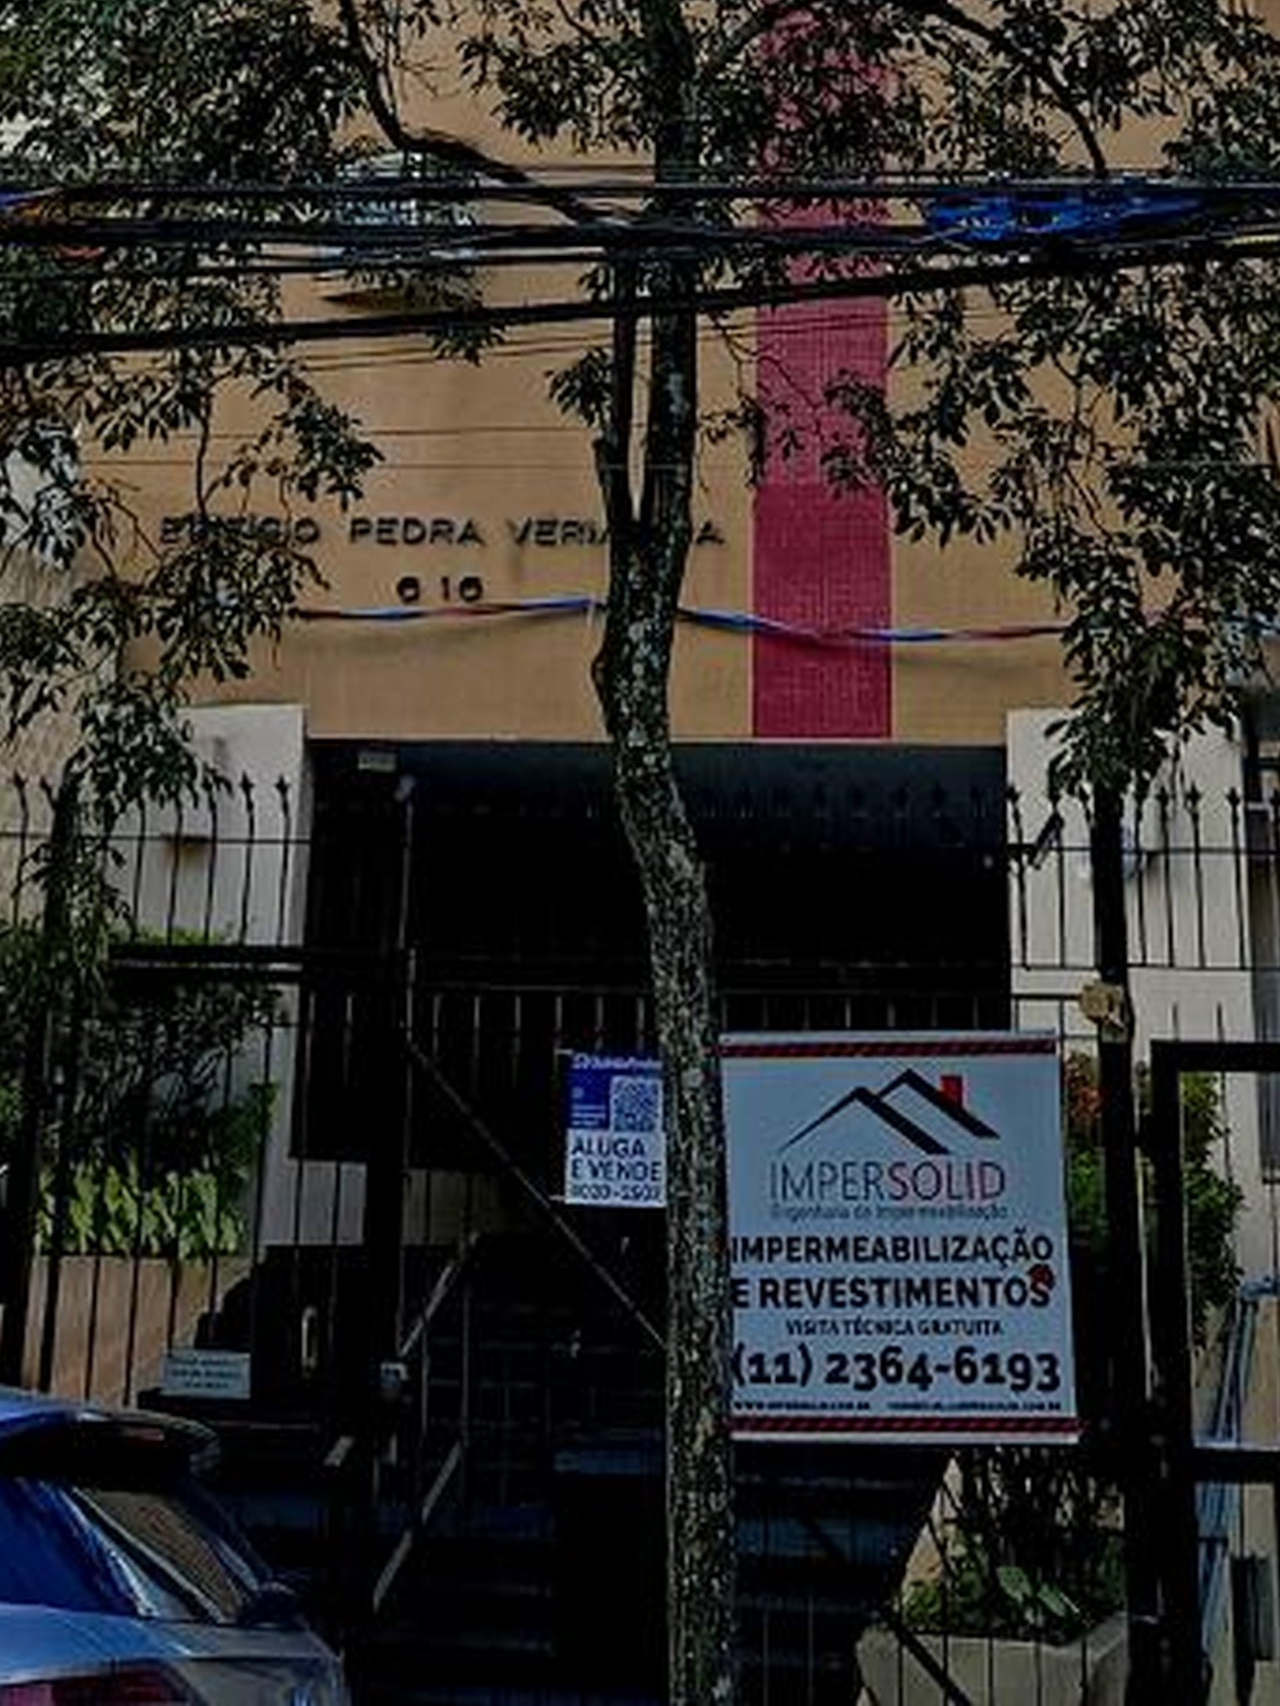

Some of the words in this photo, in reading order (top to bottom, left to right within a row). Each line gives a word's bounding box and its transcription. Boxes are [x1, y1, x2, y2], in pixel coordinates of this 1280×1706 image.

[351, 517, 485, 545] PEDRA
[571, 1139, 645, 1158] ALUGA
[587, 1160, 662, 1181] VENDE
[771, 1161, 1006, 1201] IMPERSOLID
[732, 1227, 1054, 1269] IMPERMEABILIZAÇÃO
[730, 1277, 750, 1308] E
[759, 1276, 1051, 1309] REVESTIMENTOS
[786, 1319, 840, 1335] VISITA
[844, 1315, 914, 1335] TÉCNICA
[918, 1319, 1004, 1335] GRATUITA
[733, 1342, 812, 1387] (11)
[824, 1346, 1060, 1391] 2364-6193
